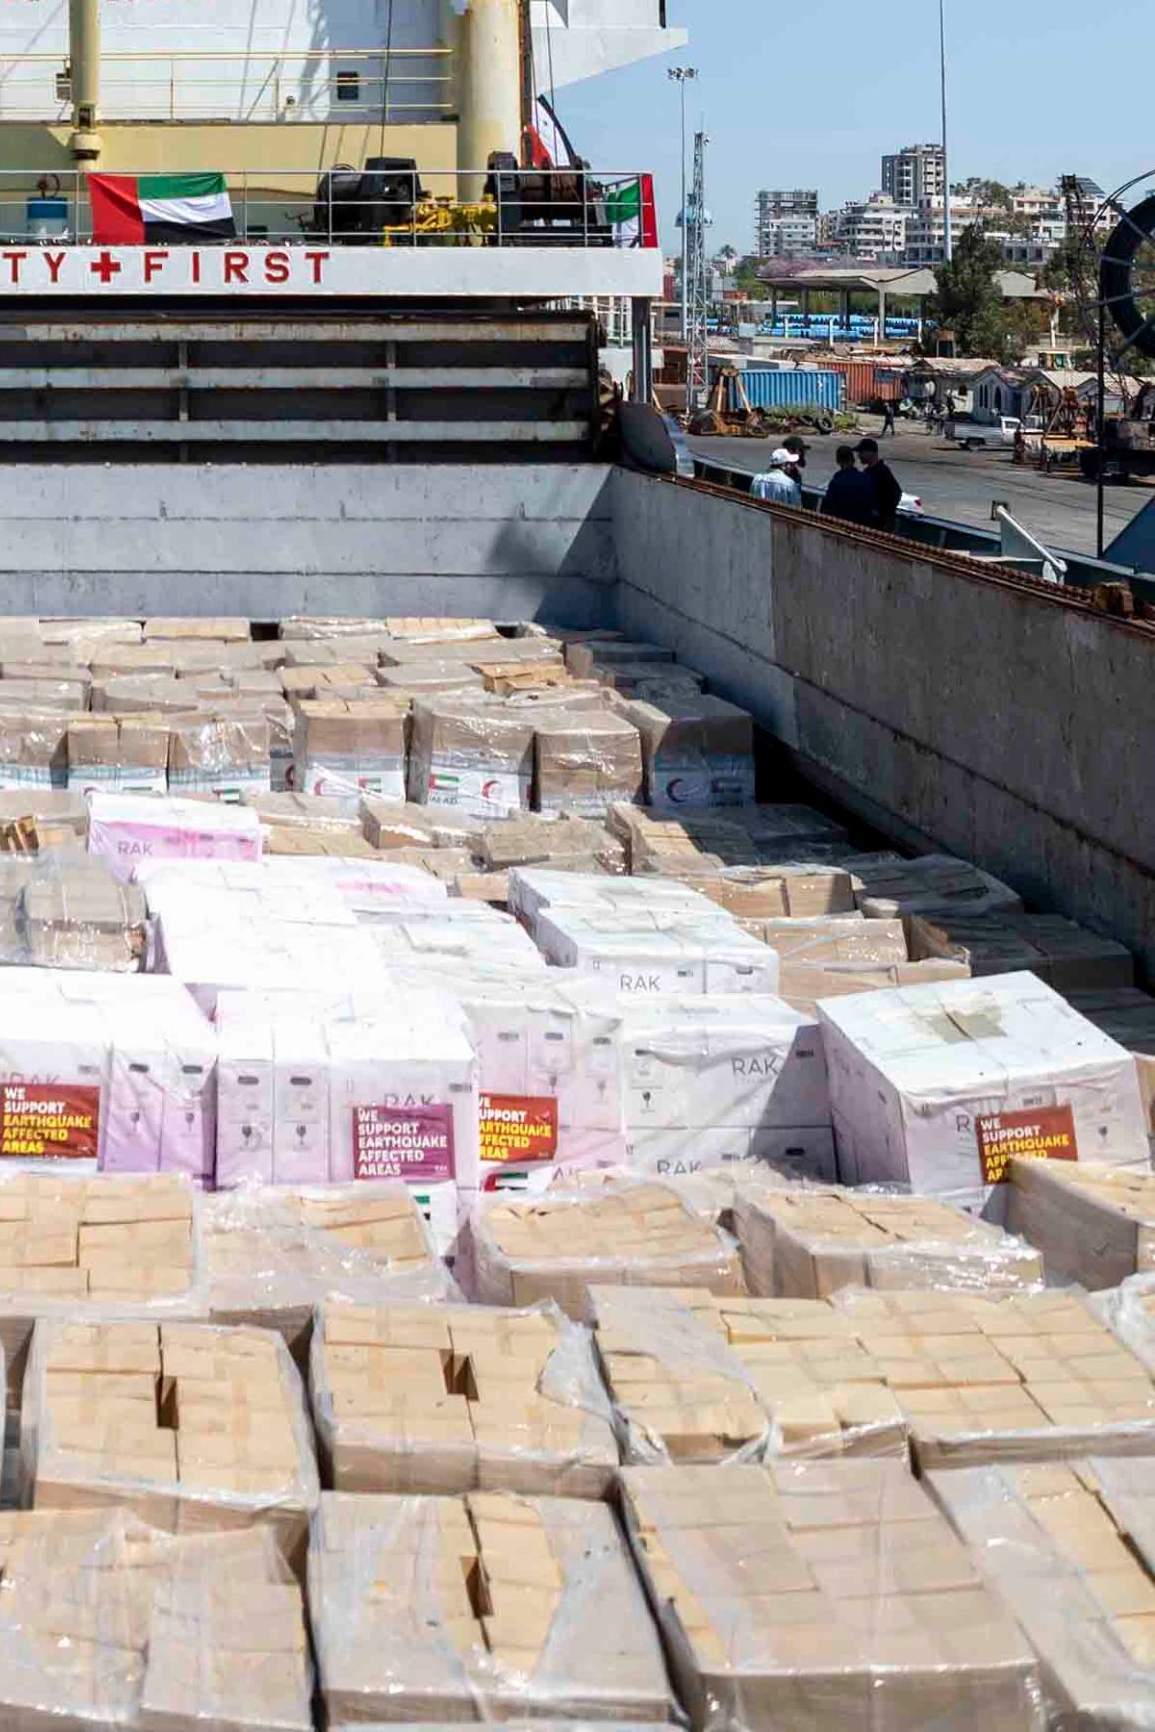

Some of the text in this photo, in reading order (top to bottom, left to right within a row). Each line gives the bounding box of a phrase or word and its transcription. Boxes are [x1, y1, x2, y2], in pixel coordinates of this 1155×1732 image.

[144, 252, 331, 283] FIRST
[118, 841, 153, 855] RAK
[620, 974, 661, 992] RAK
[732, 1056, 780, 1075] RAK
[4, 1087, 26, 1100] WE
[4, 1100, 66, 1114] SUPPORT
[3, 1115, 93, 1128] EARTHQUAKE
[358, 1108, 378, 1122] WE
[479, 1108, 527, 1123] UPPORT
[358, 1121, 420, 1136] SUPPORT
[479, 1121, 552, 1138] ARTHQUAKE
[980, 1117, 1001, 1130] WE
[2, 1128, 69, 1141] AFFECTED
[479, 1134, 530, 1148] FFECTED
[982, 1125, 1041, 1143] SUPPORT
[1, 1140, 46, 1154] AREAS
[358, 1135, 448, 1149] EARTHQUAKE
[984, 1134, 1070, 1156] EARTHQUAKE
[358, 1149, 425, 1163] AFFECTED
[479, 1145, 508, 1160] REAS
[358, 1163, 402, 1176] AREAS
